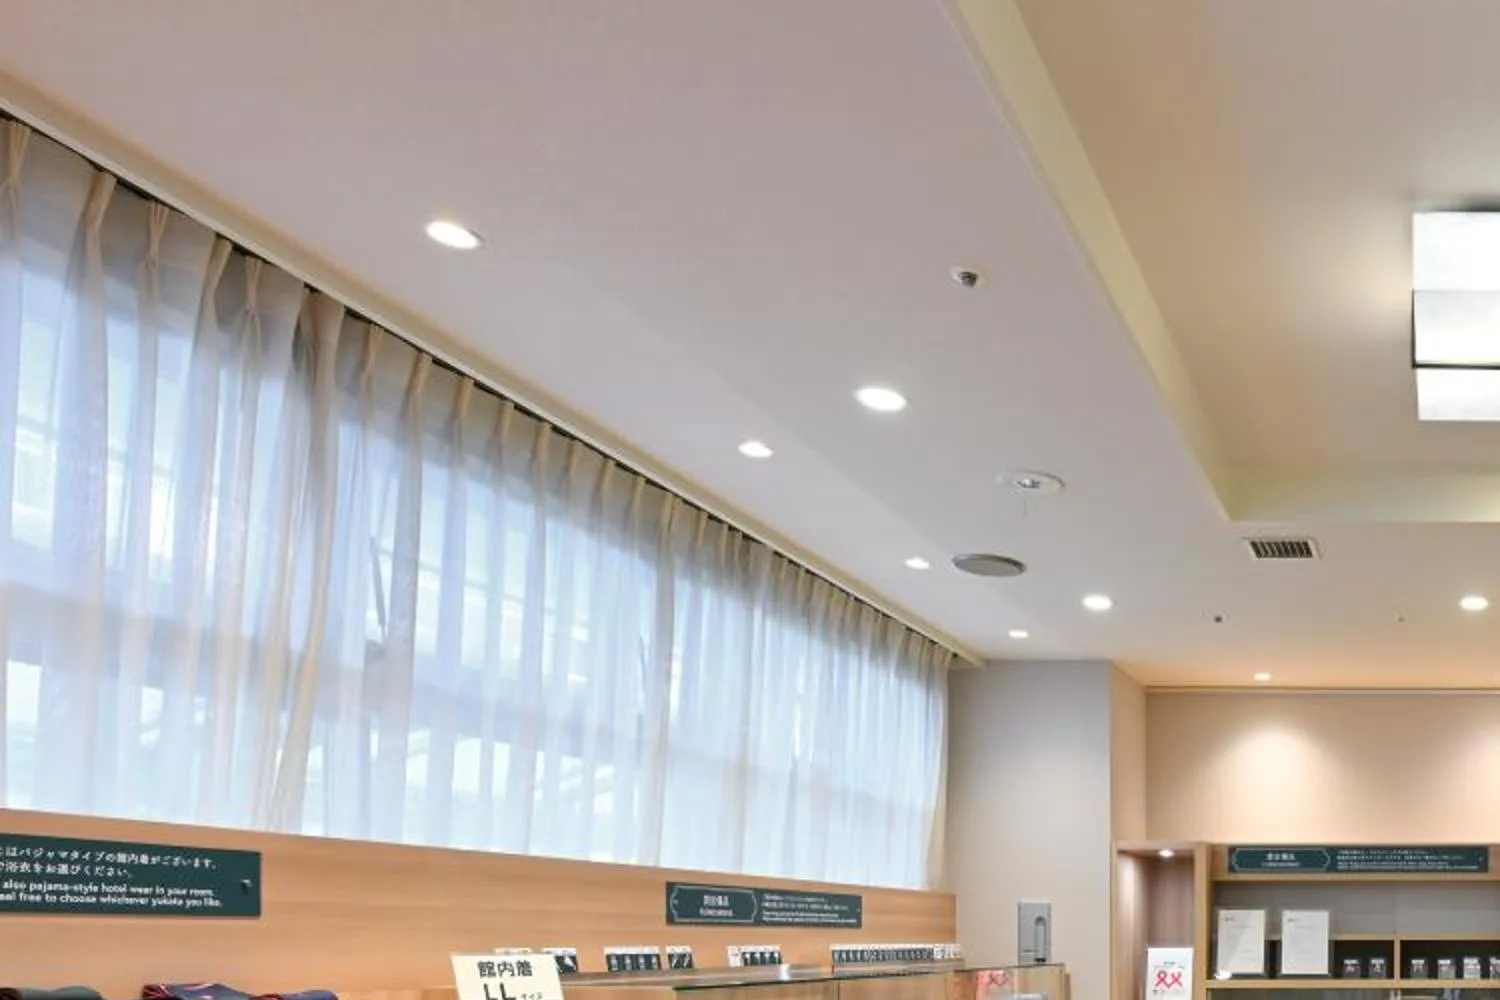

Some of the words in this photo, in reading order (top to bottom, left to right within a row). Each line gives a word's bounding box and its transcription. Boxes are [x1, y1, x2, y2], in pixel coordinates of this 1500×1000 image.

[19, 892, 42, 901] free
[45, 893, 57, 903] to
[60, 894, 97, 903] choose
[478, 960, 533, 978] 館内着
